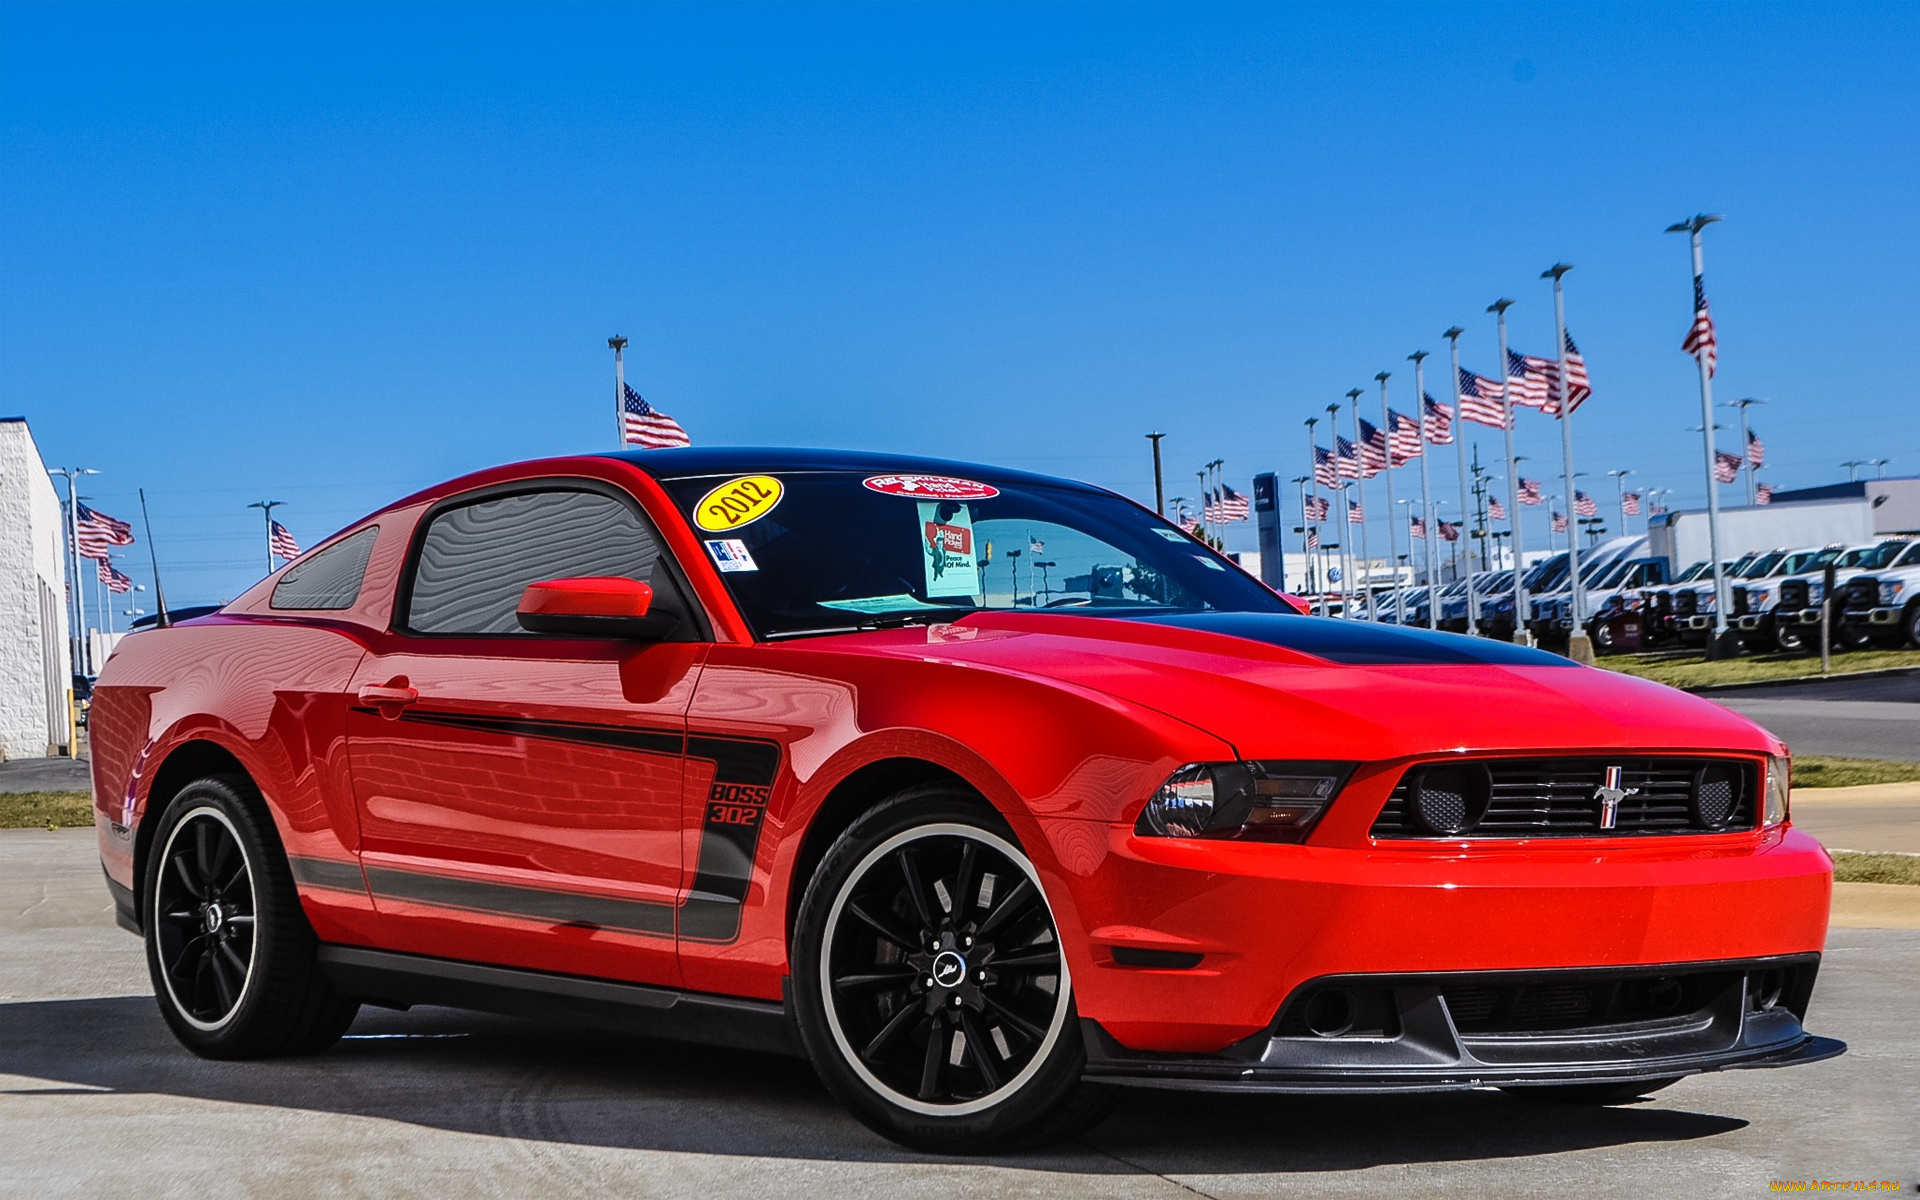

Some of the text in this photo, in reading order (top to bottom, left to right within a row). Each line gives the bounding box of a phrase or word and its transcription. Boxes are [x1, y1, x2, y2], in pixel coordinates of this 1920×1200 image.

[709, 481, 772, 524] 2012
[709, 784, 769, 805] BOSS
[711, 805, 758, 826] 302
